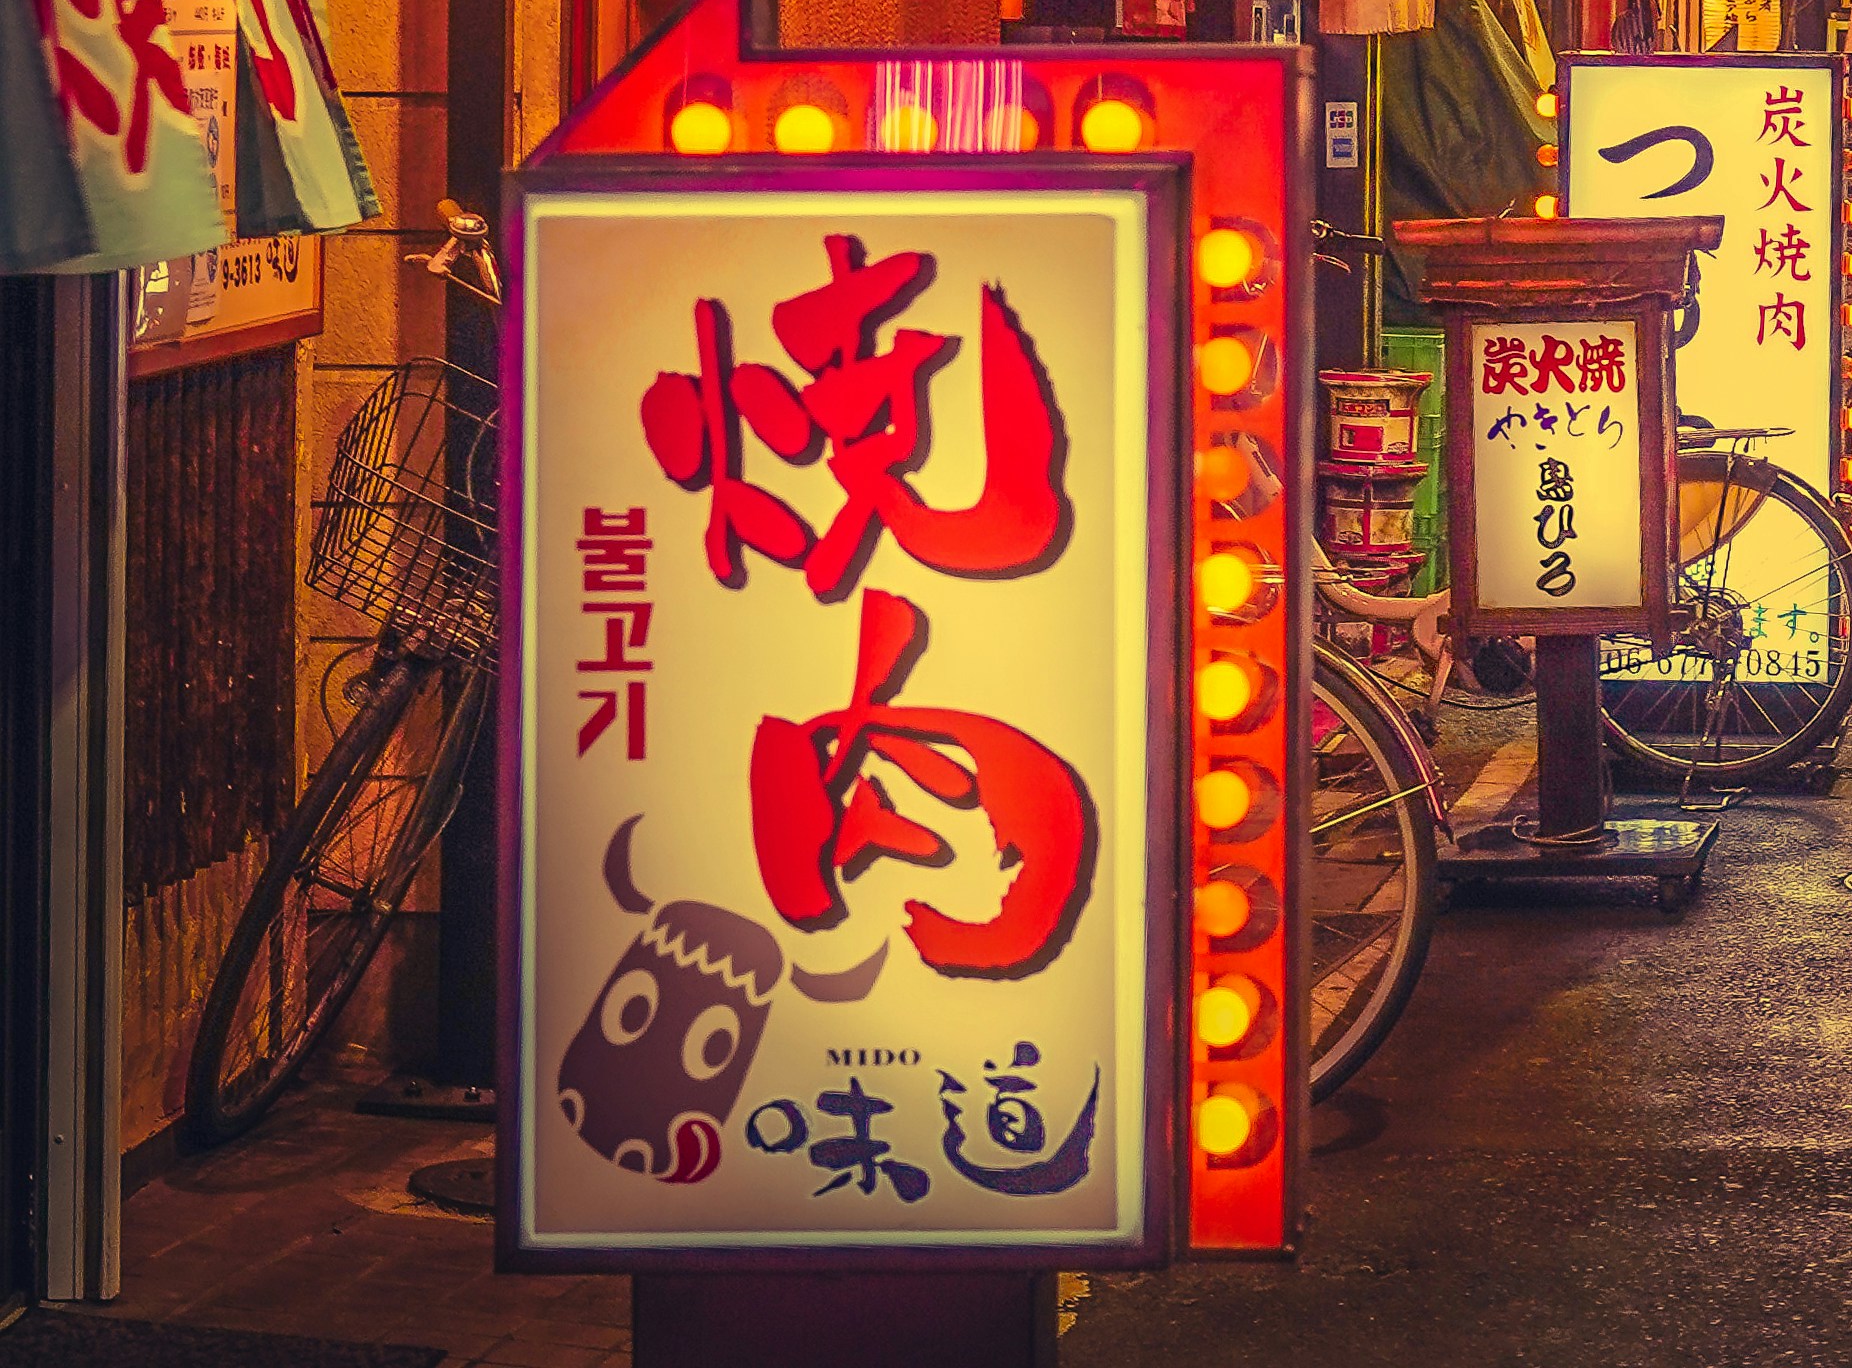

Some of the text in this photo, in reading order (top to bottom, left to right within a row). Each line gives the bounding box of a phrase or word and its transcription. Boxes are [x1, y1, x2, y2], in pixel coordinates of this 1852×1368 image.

[1753, 85, 1814, 353] 炭火焼肉
[1482, 333, 1626, 395] 炭火焼
[641, 234, 1100, 981] 焼肉
[1532, 457, 1578, 597] 鳥ひろ
[575, 506, 654, 763] 불고기
[745, 1039, 1101, 1203] 味道
[825, 1046, 922, 1067] MIDO
